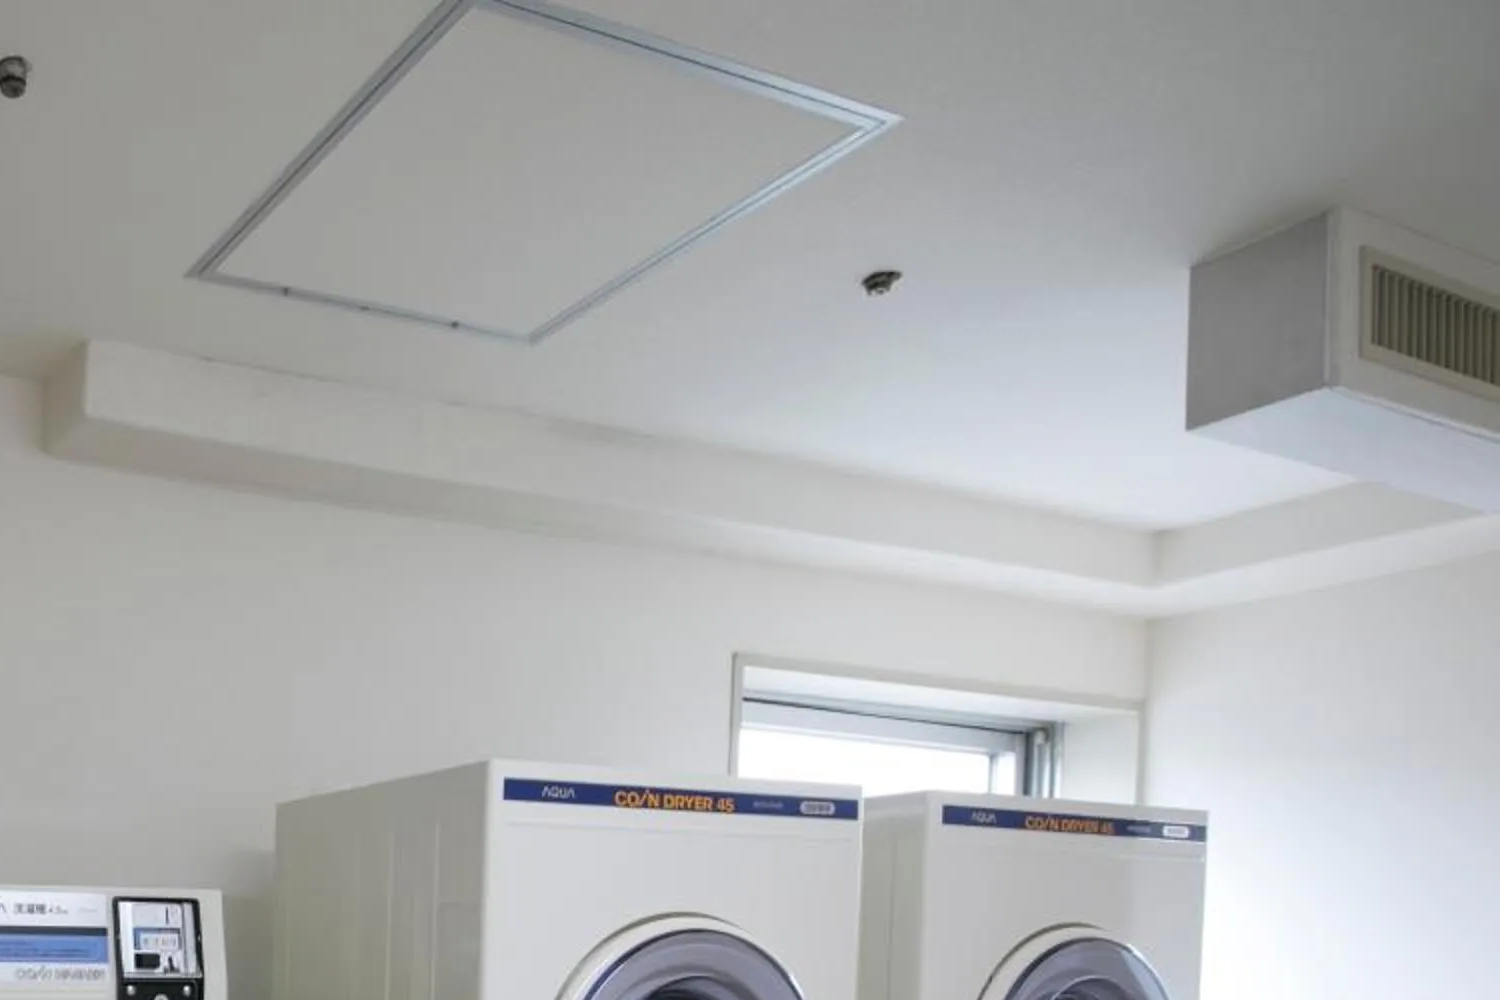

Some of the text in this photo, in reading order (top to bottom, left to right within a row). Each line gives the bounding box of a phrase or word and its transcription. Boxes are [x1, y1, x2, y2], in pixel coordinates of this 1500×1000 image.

[541, 784, 575, 799] AQUA
[663, 794, 714, 812] DRYER
[717, 798, 735, 813] 45
[13, 903, 47, 915] 洗濯機
